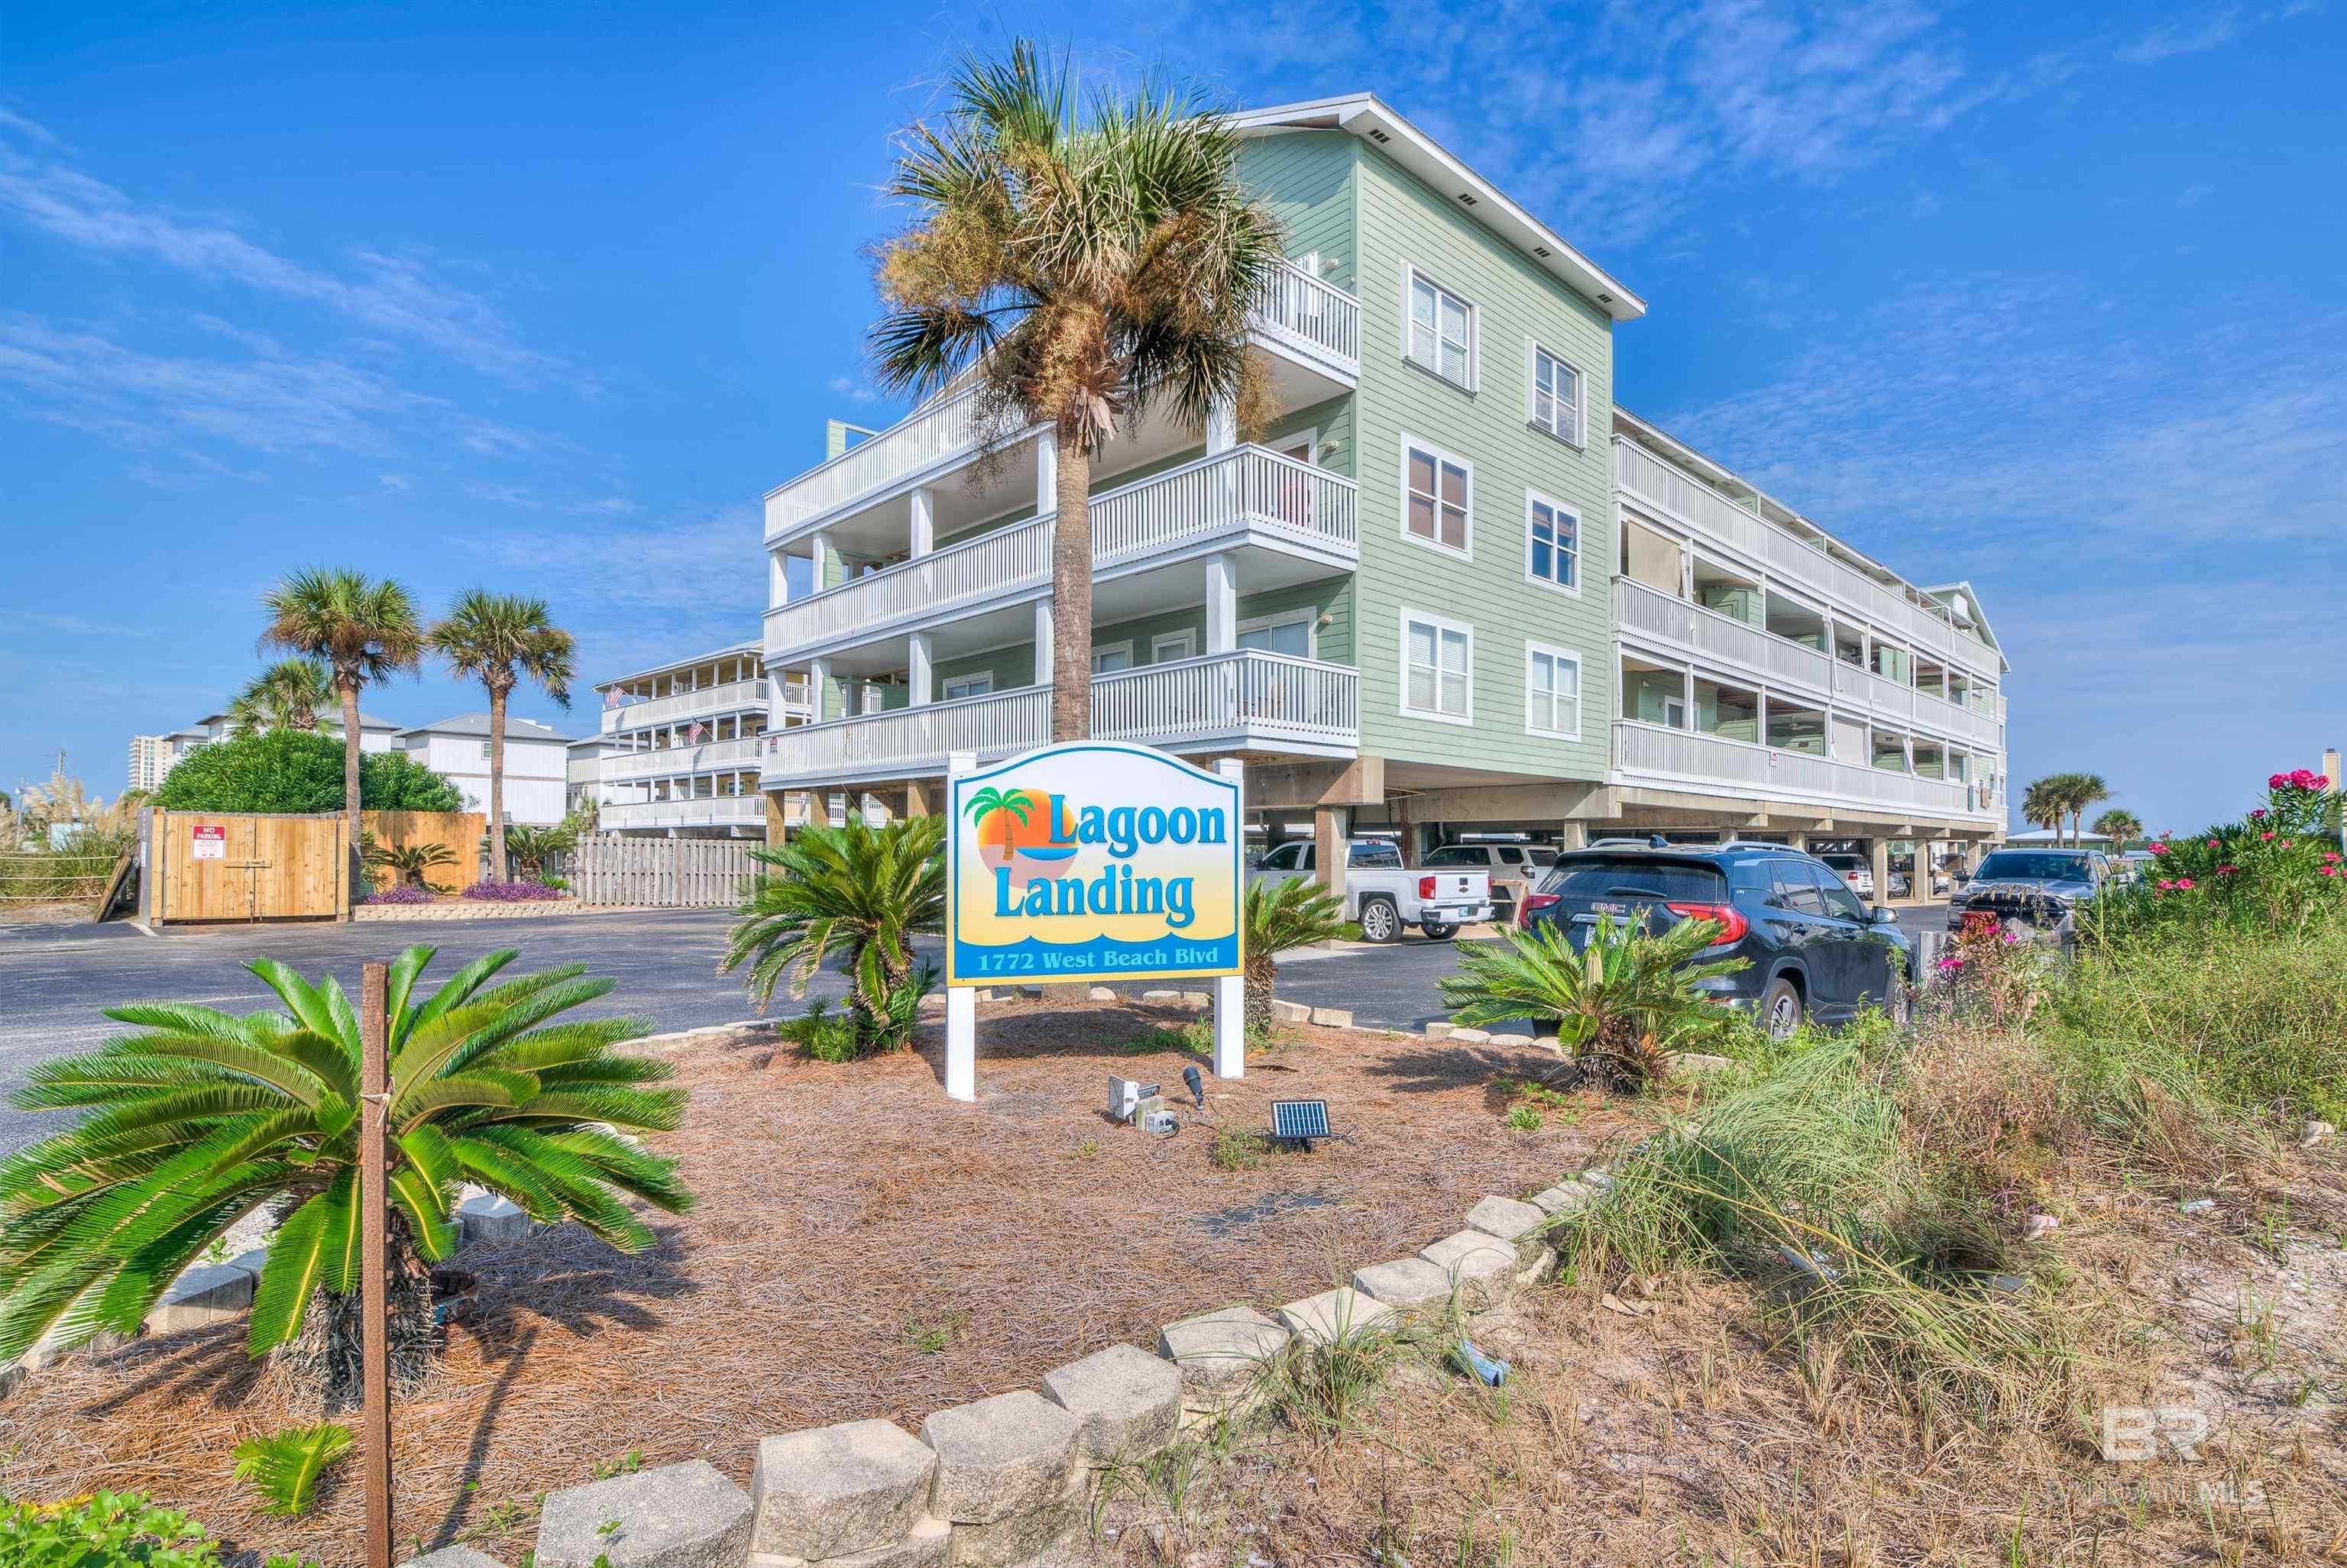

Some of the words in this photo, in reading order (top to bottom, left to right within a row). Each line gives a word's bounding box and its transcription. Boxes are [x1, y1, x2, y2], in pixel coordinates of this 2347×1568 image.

[1048, 794, 1227, 858] Lagoon
[995, 864, 1196, 929] Landing
[978, 952, 1035, 971] 1772
[1043, 951, 1096, 968] West
[1104, 949, 1168, 967] Beach
[1175, 946, 1219, 965] Blvd
